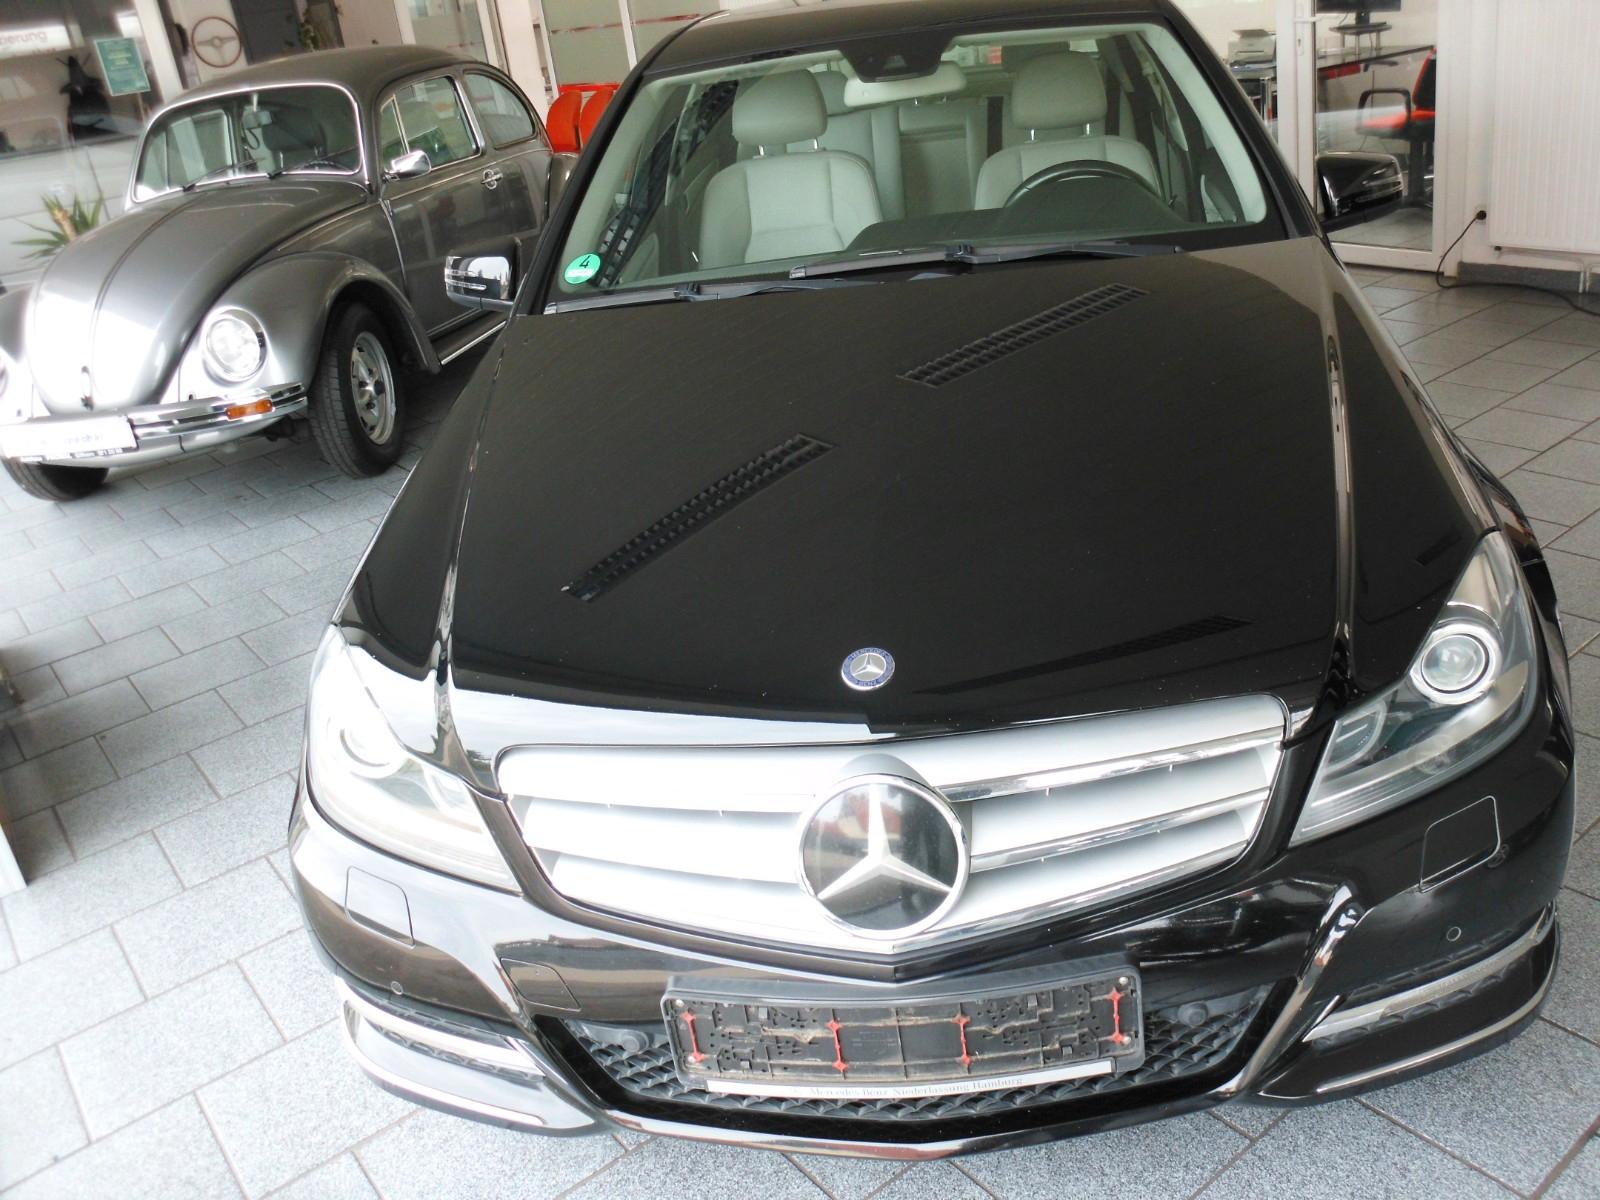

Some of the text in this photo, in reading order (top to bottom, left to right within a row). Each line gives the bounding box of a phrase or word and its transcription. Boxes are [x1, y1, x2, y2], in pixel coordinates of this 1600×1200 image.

[579, 255, 591, 268] 4
[893, 1083, 970, 1096] Niederlassung
[972, 1078, 1023, 1090] Hamburg
